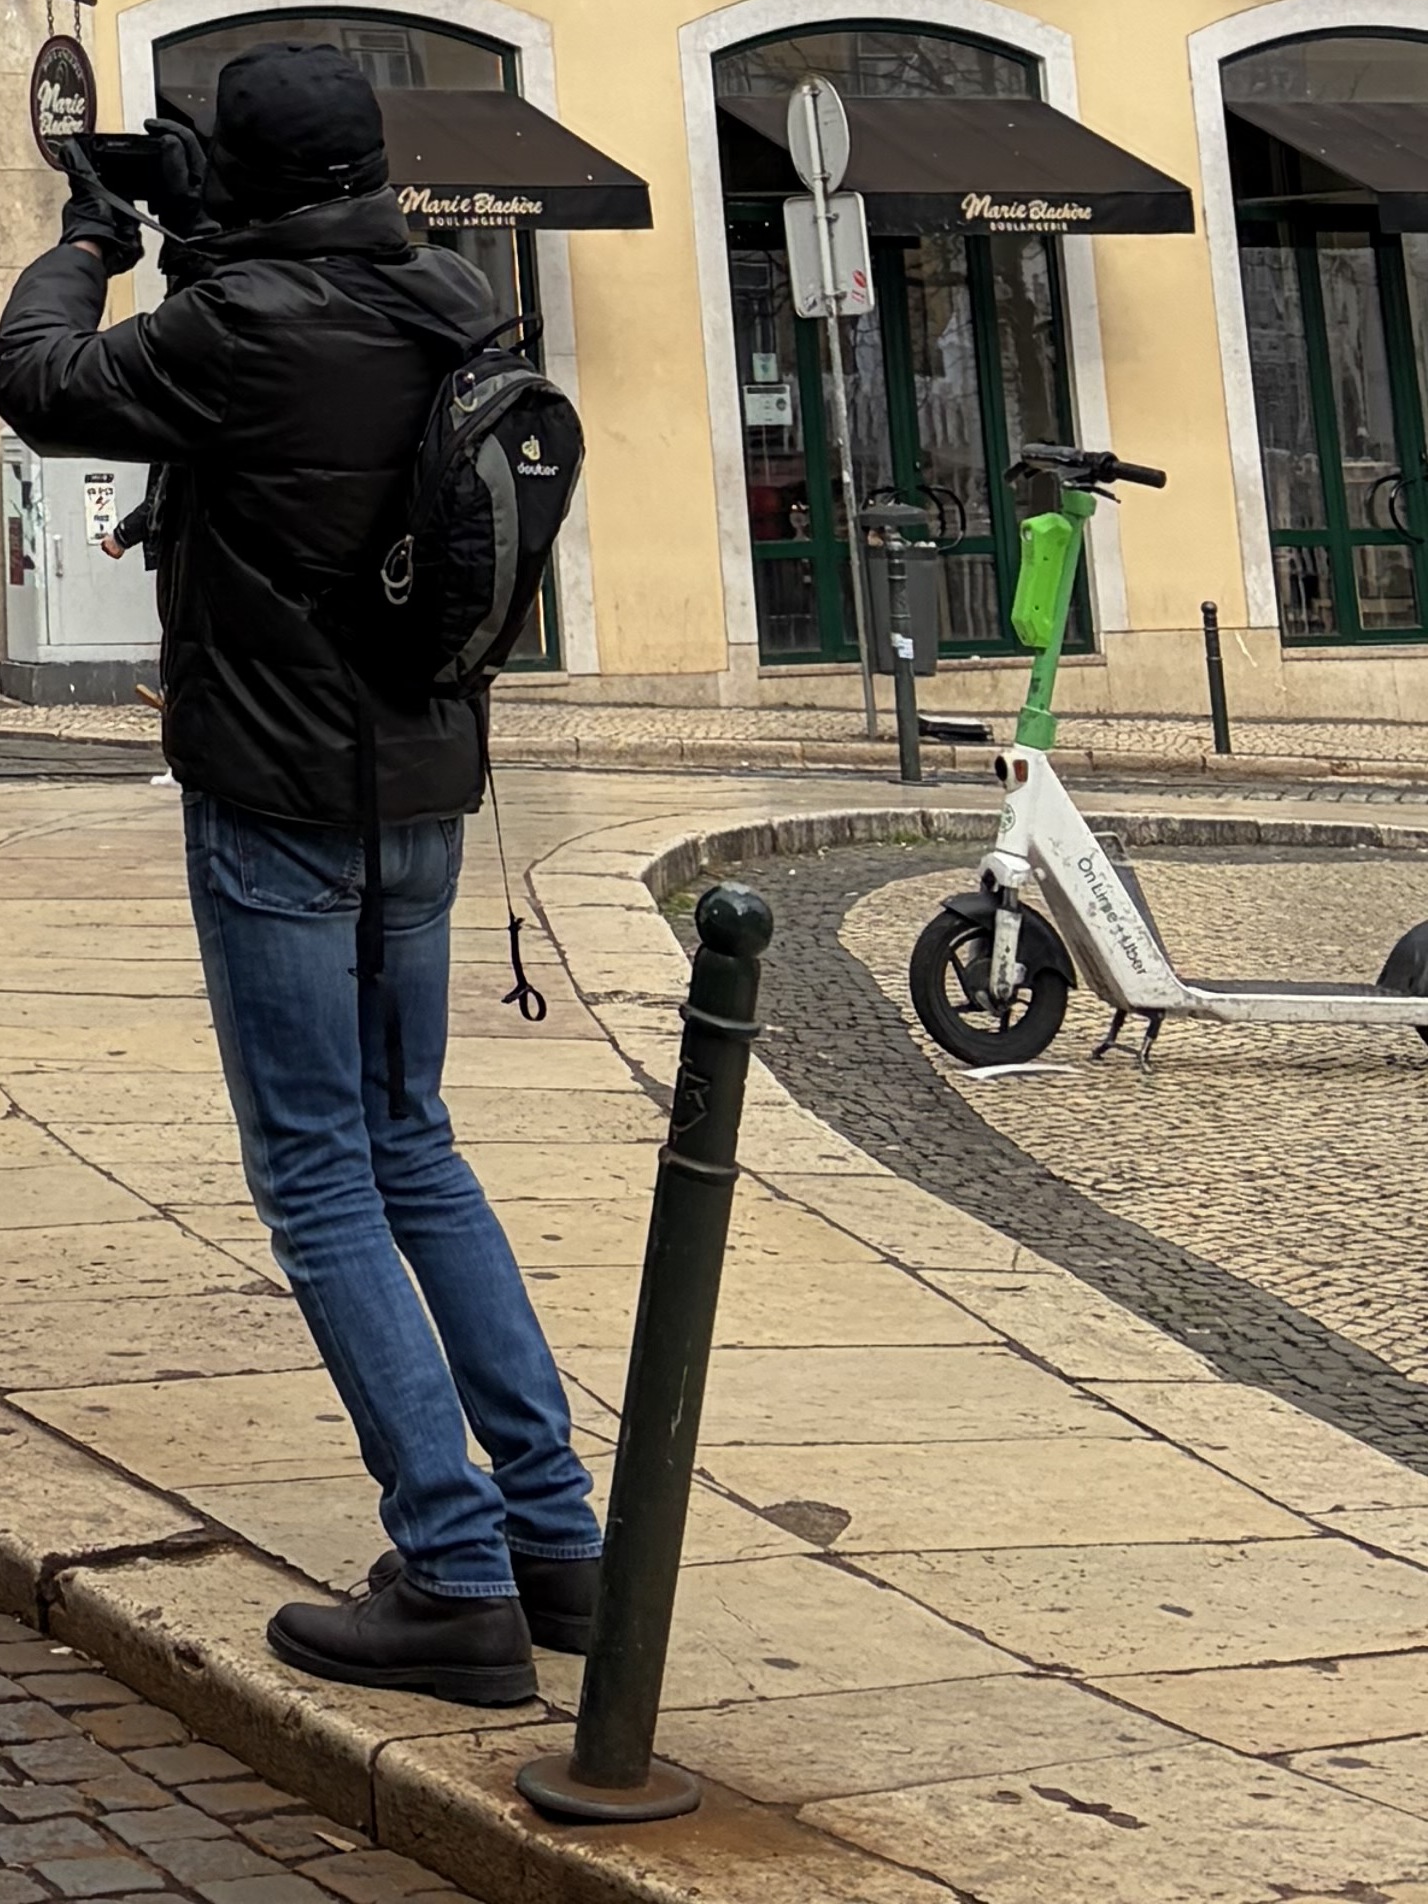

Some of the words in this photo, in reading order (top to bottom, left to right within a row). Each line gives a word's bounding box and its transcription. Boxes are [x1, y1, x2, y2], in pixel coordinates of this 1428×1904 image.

[37, 79, 85, 115] Marie
[397, 186, 472, 214] Marie
[472, 192, 543, 215] Blachère
[960, 192, 1028, 220] Marie
[428, 216, 517, 227] BOULANGERIE
[517, 462, 560, 476] deuter
[1077, 857, 1097, 883] On
[1091, 882, 1119, 923] Lime
[1120, 935, 1147, 974] Uber
